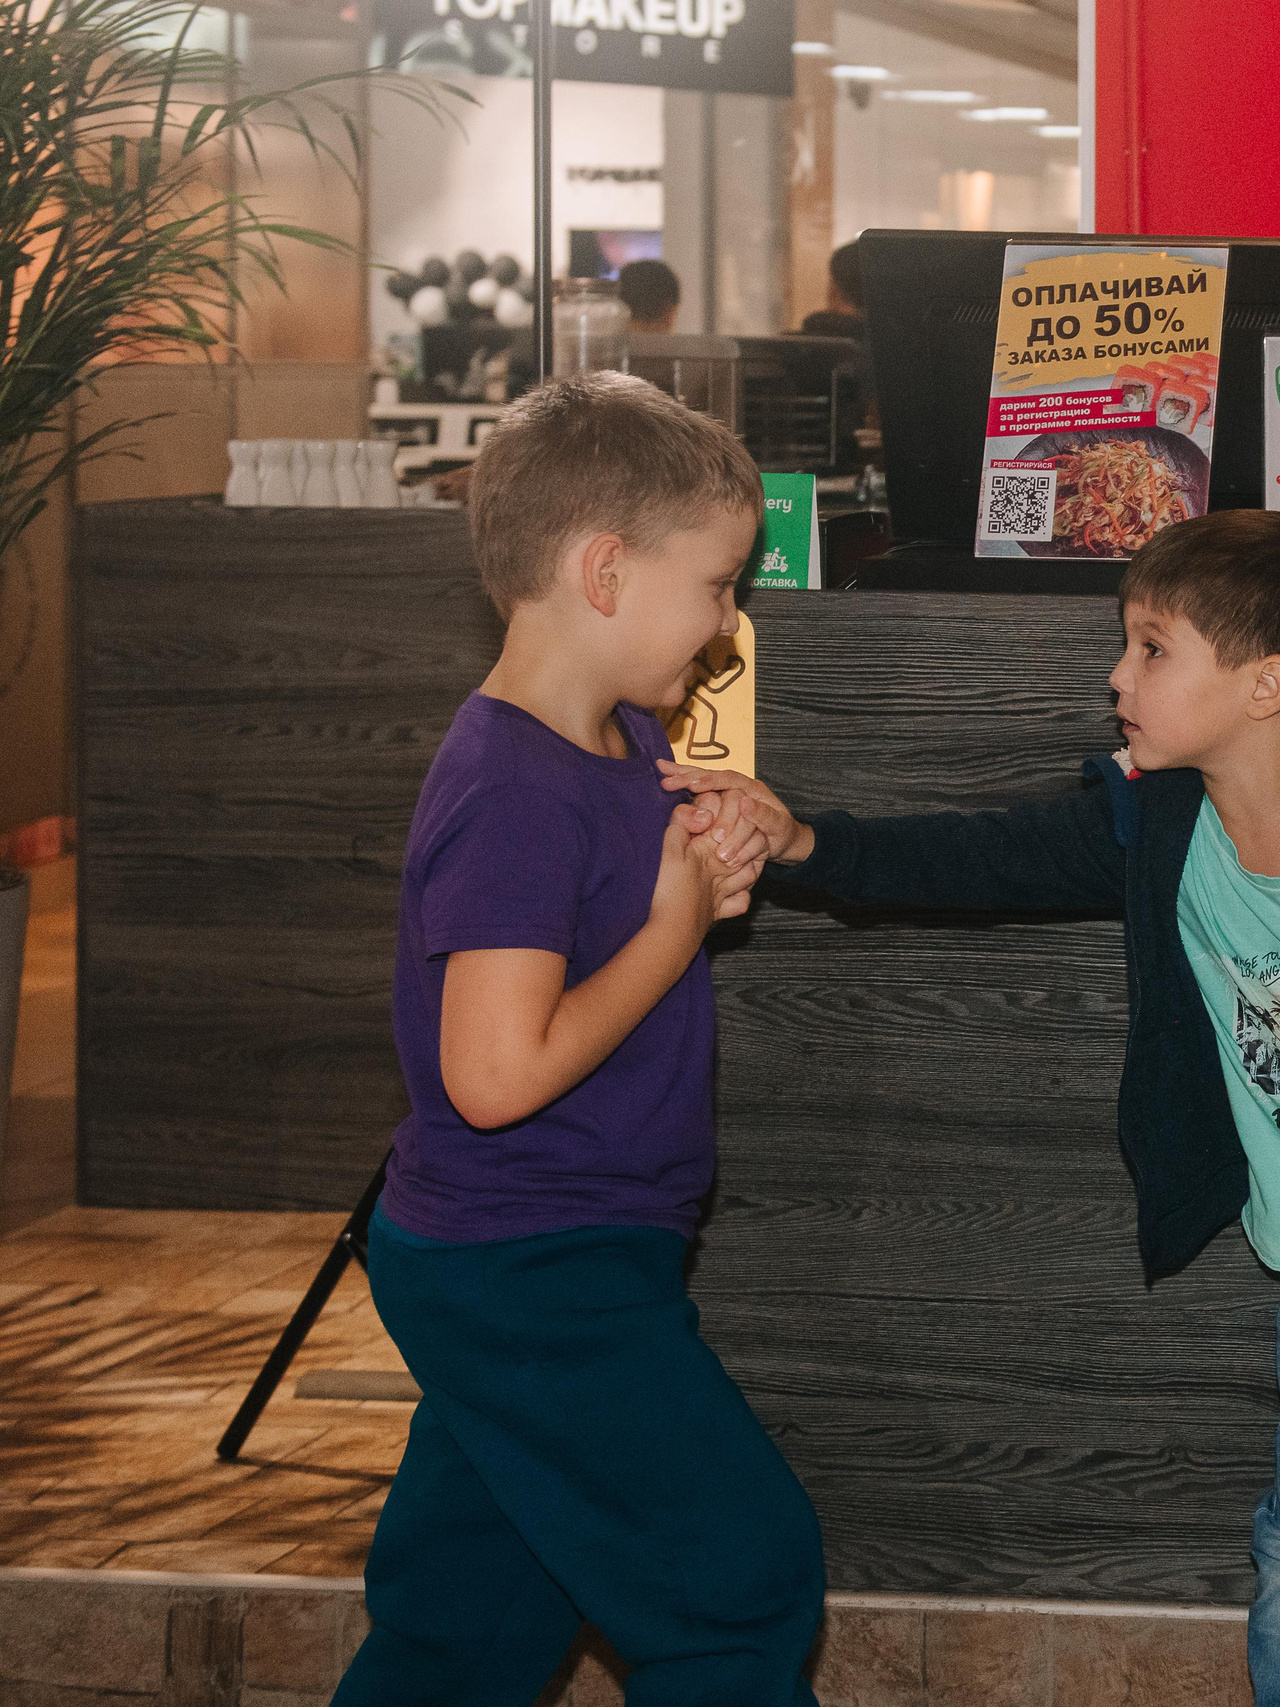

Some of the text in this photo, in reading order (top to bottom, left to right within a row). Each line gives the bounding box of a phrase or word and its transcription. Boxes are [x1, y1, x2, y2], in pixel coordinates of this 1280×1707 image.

[1011, 268, 1207, 307] ОПЛАЧИВАЙ
[1026, 302, 1184, 347] ДО 50%
[1007, 337, 1209, 366] ЗАКАЗА БОНУСАМИ
[999, 394, 1112, 412] дарим 200 бонусов
[1000, 408, 1090, 421] за регистрацию
[1000, 415, 1141, 433] в программе лояльности
[993, 461, 1053, 469] РЕГИСТРИРУЙСЯ
[763, 498, 792, 513] ery
[751, 578, 798, 588] ОСТАВКА
